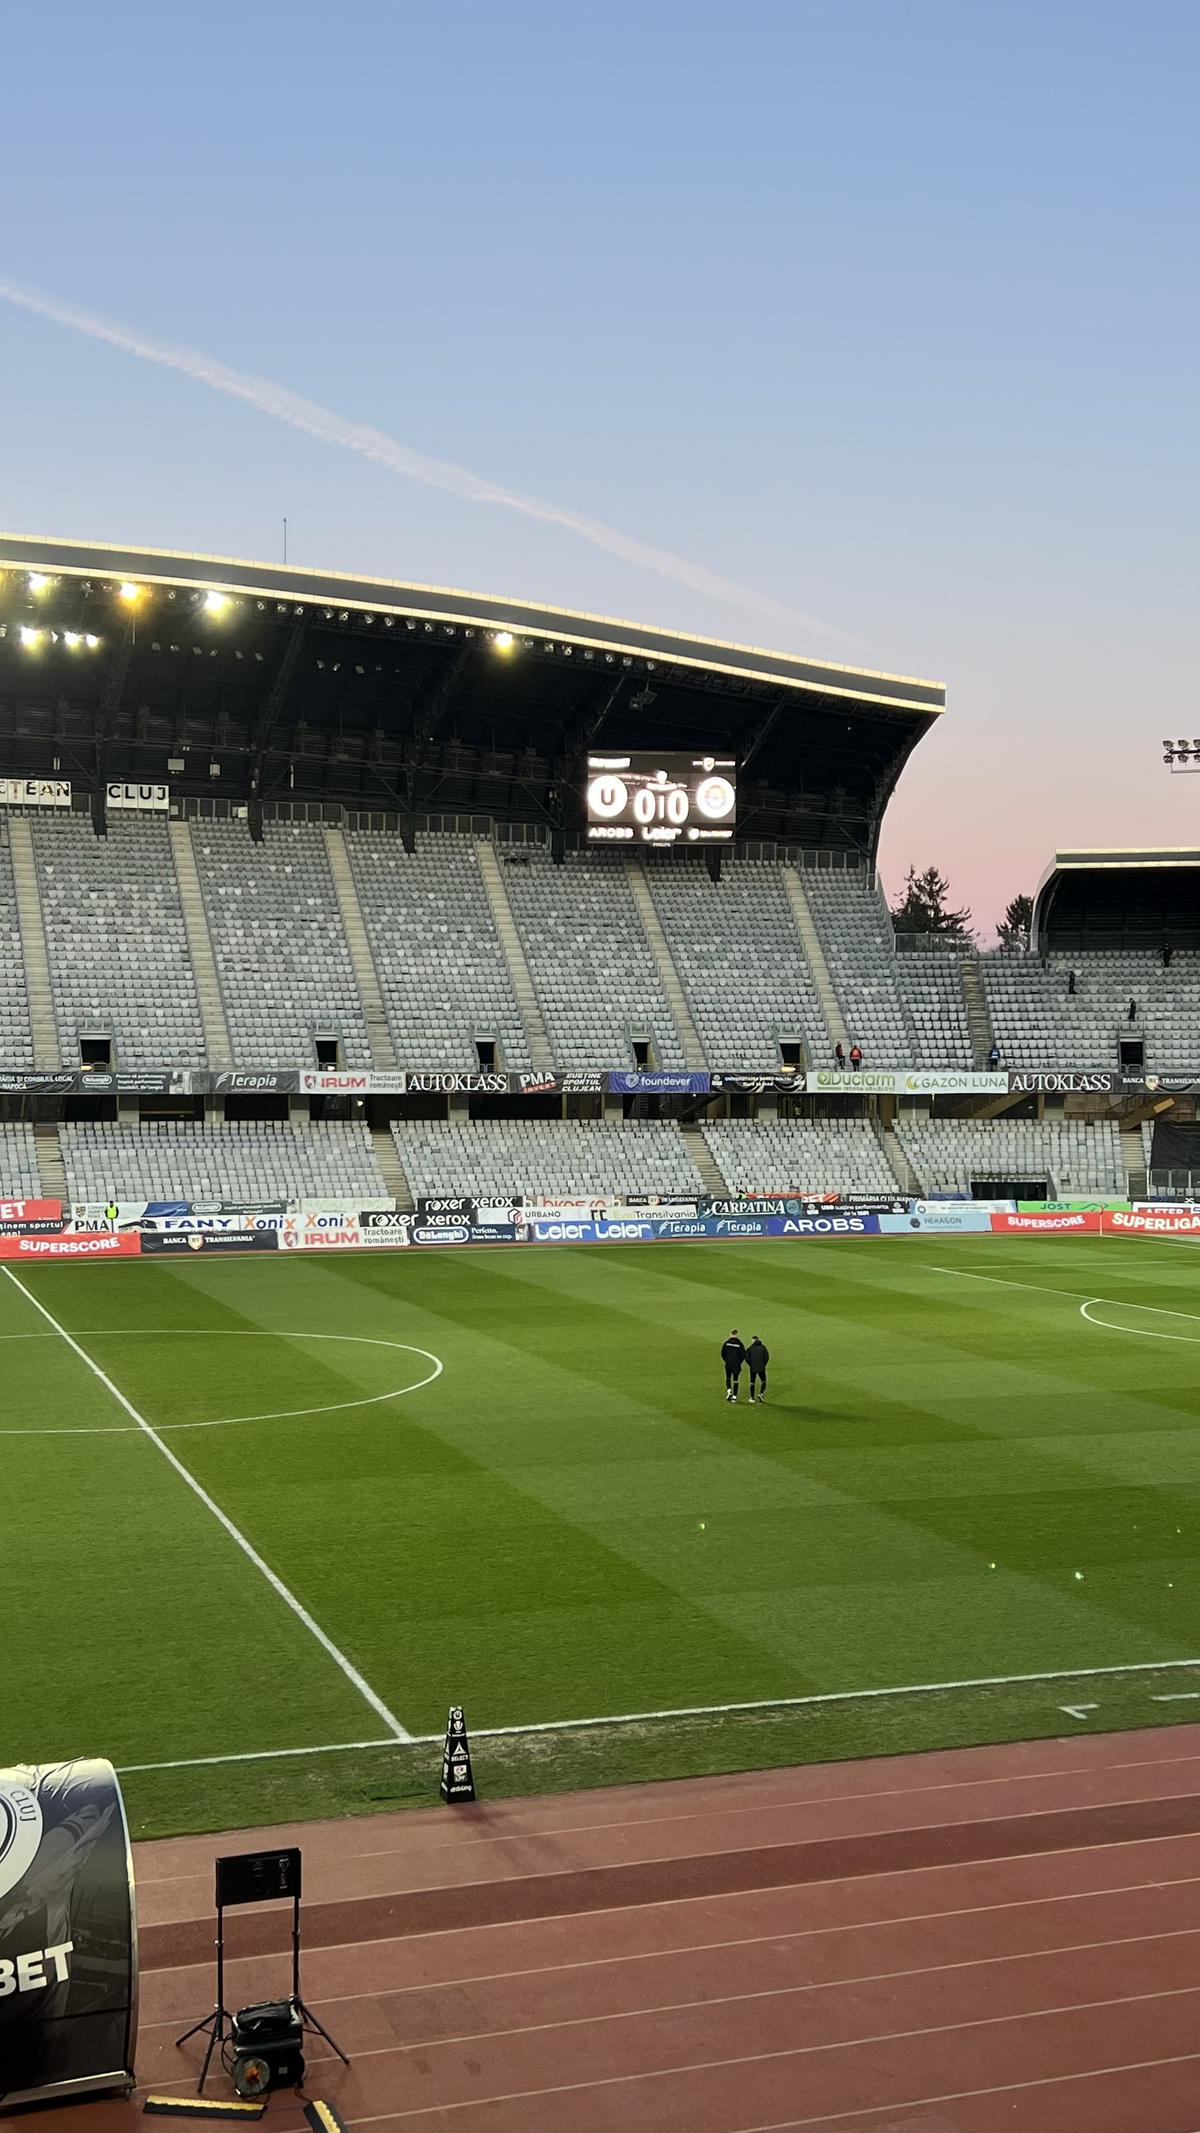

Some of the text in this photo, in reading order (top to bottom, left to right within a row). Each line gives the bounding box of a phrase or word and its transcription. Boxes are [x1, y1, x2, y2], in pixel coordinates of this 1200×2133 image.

[108, 784, 167, 800] CLUJ
[634, 789, 689, 824] 0 0
[229, 1072, 277, 1089] Terapia
[321, 1077, 366, 1088] IRUM
[408, 1073, 507, 1091] AUTOKLASS
[519, 1072, 555, 1087] PMA
[641, 1077, 691, 1086] foundever
[921, 1077, 1007, 1088] GAZON LUNA
[1011, 1074, 1111, 1091] AUTOKLASS
[471, 1196, 514, 1209] xerox
[712, 1199, 786, 1215] CARPATINA
[305, 1213, 355, 1228] Xonix
[426, 1214, 471, 1226] xerox
[525, 1210, 561, 1218] URBANO
[30, 1222, 64, 1231] sportul
[75, 1220, 109, 1231] PMA
[165, 1218, 232, 1229] FANY
[245, 1214, 296, 1230] Xonix
[667, 1221, 706, 1234] Terapia
[723, 1220, 761, 1233] Terapia
[783, 1218, 865, 1233] AROBS
[1007, 1215, 1086, 1229] SUPERSCORE
[305, 1231, 359, 1245] IRUM
[535, 1222, 651, 1240] Leier Leier
[19, 1236, 120, 1253] SUPERSCORE
[10, 1790, 36, 1822] CLUJ
